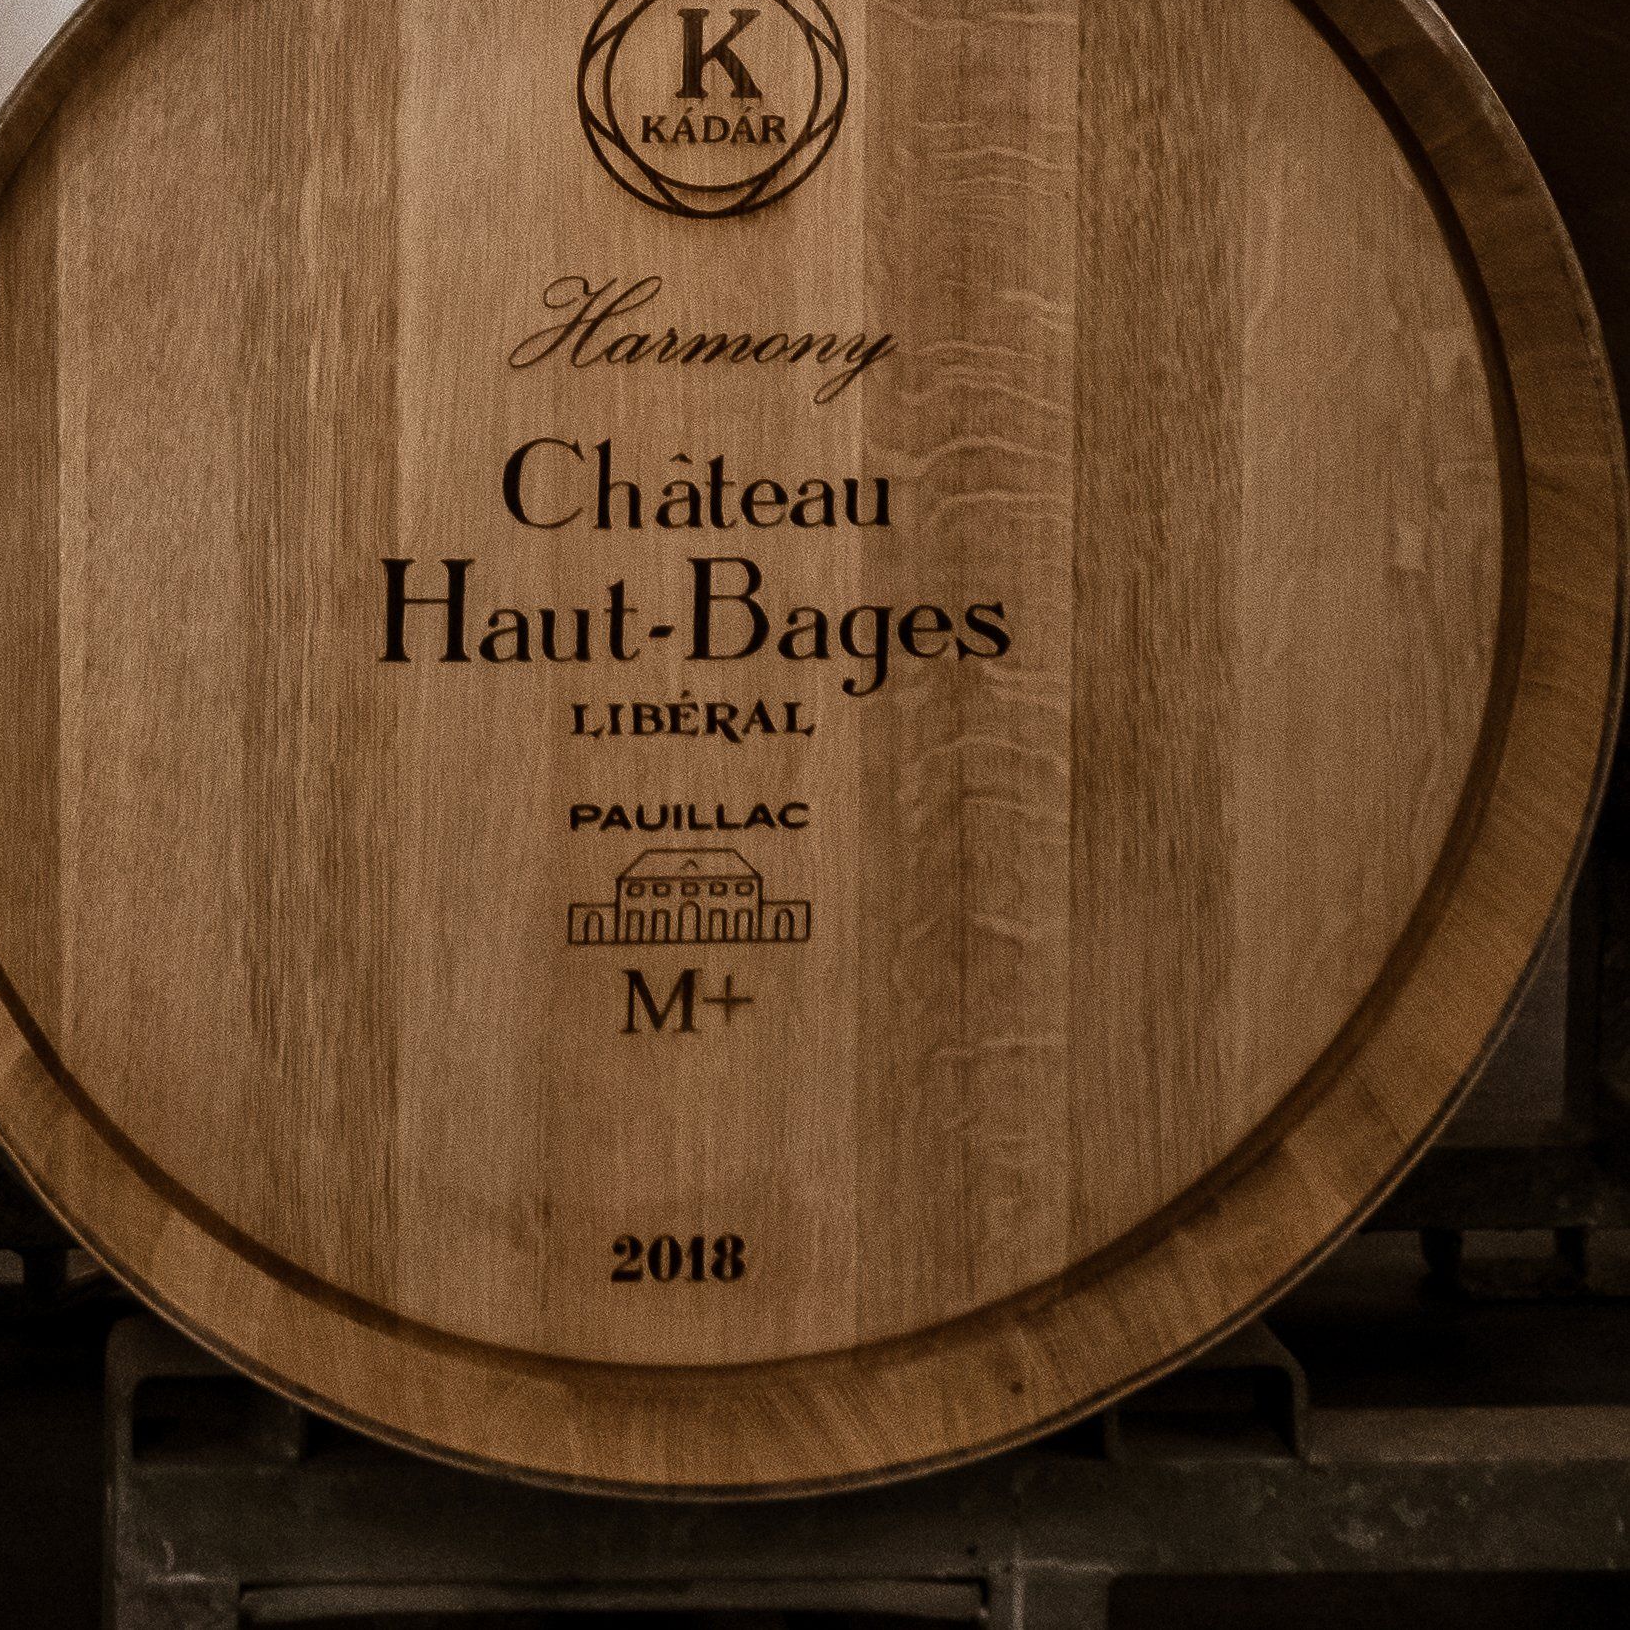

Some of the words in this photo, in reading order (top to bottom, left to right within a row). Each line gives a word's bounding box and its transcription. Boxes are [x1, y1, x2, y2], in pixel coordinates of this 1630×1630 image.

[675, 8, 763, 100] K
[640, 106, 787, 147] KÁDÁR
[510, 276, 898, 403] Harmony
[502, 438, 891, 530] Château
[380, 557, 1012, 697] Haut-Bages
[572, 691, 814, 744] LIBÉRAL
[569, 801, 808, 832] PAUILLAC
[622, 968, 752, 1035] M+
[611, 1235, 745, 1283] 2018
